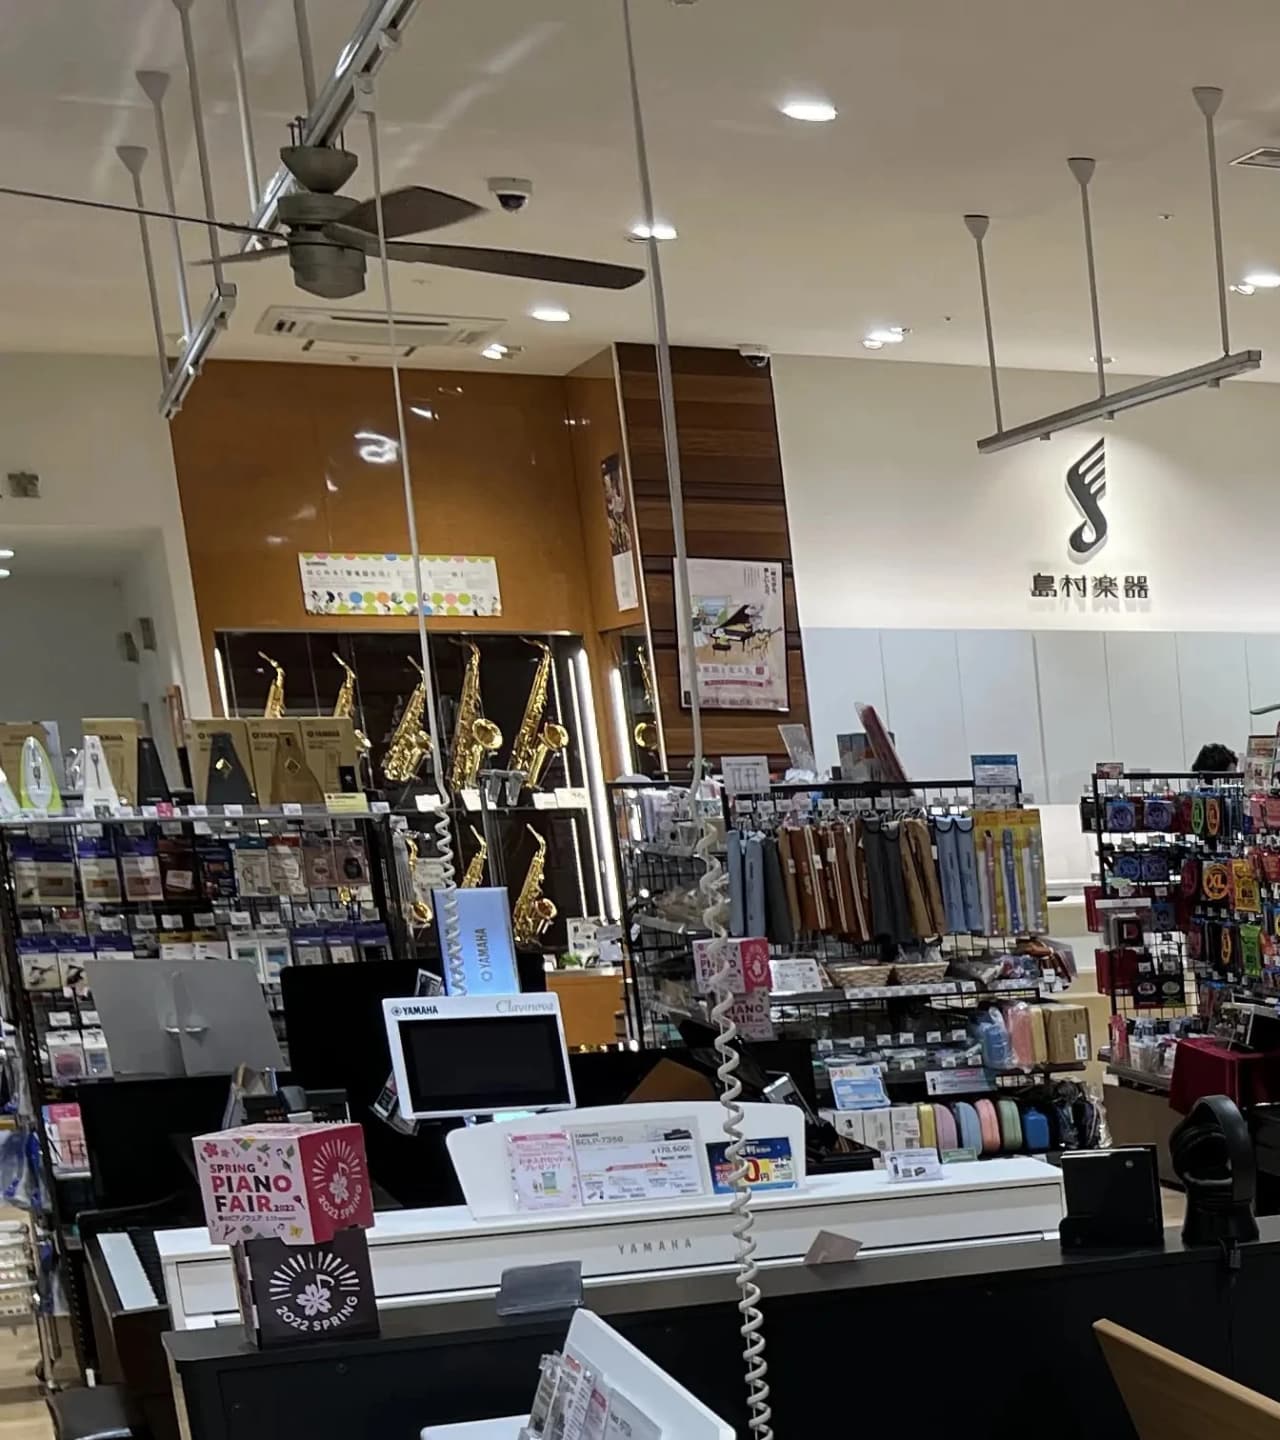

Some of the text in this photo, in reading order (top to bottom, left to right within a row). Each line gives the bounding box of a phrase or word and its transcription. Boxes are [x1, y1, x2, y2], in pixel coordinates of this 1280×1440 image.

[1030, 572, 1149, 599] 島村楽器
[475, 928, 490, 967] YAMAHA
[402, 1005, 438, 1015] YAMAHA
[209, 1163, 256, 1174] SPRING
[211, 1175, 293, 1194] PIANO
[216, 1195, 296, 1213] FAIR 2022
[318, 1184, 362, 1220] 2022 SPRING
[617, 1238, 694, 1256] YAMAHA
[276, 1296, 358, 1331] 2022 SPRING
